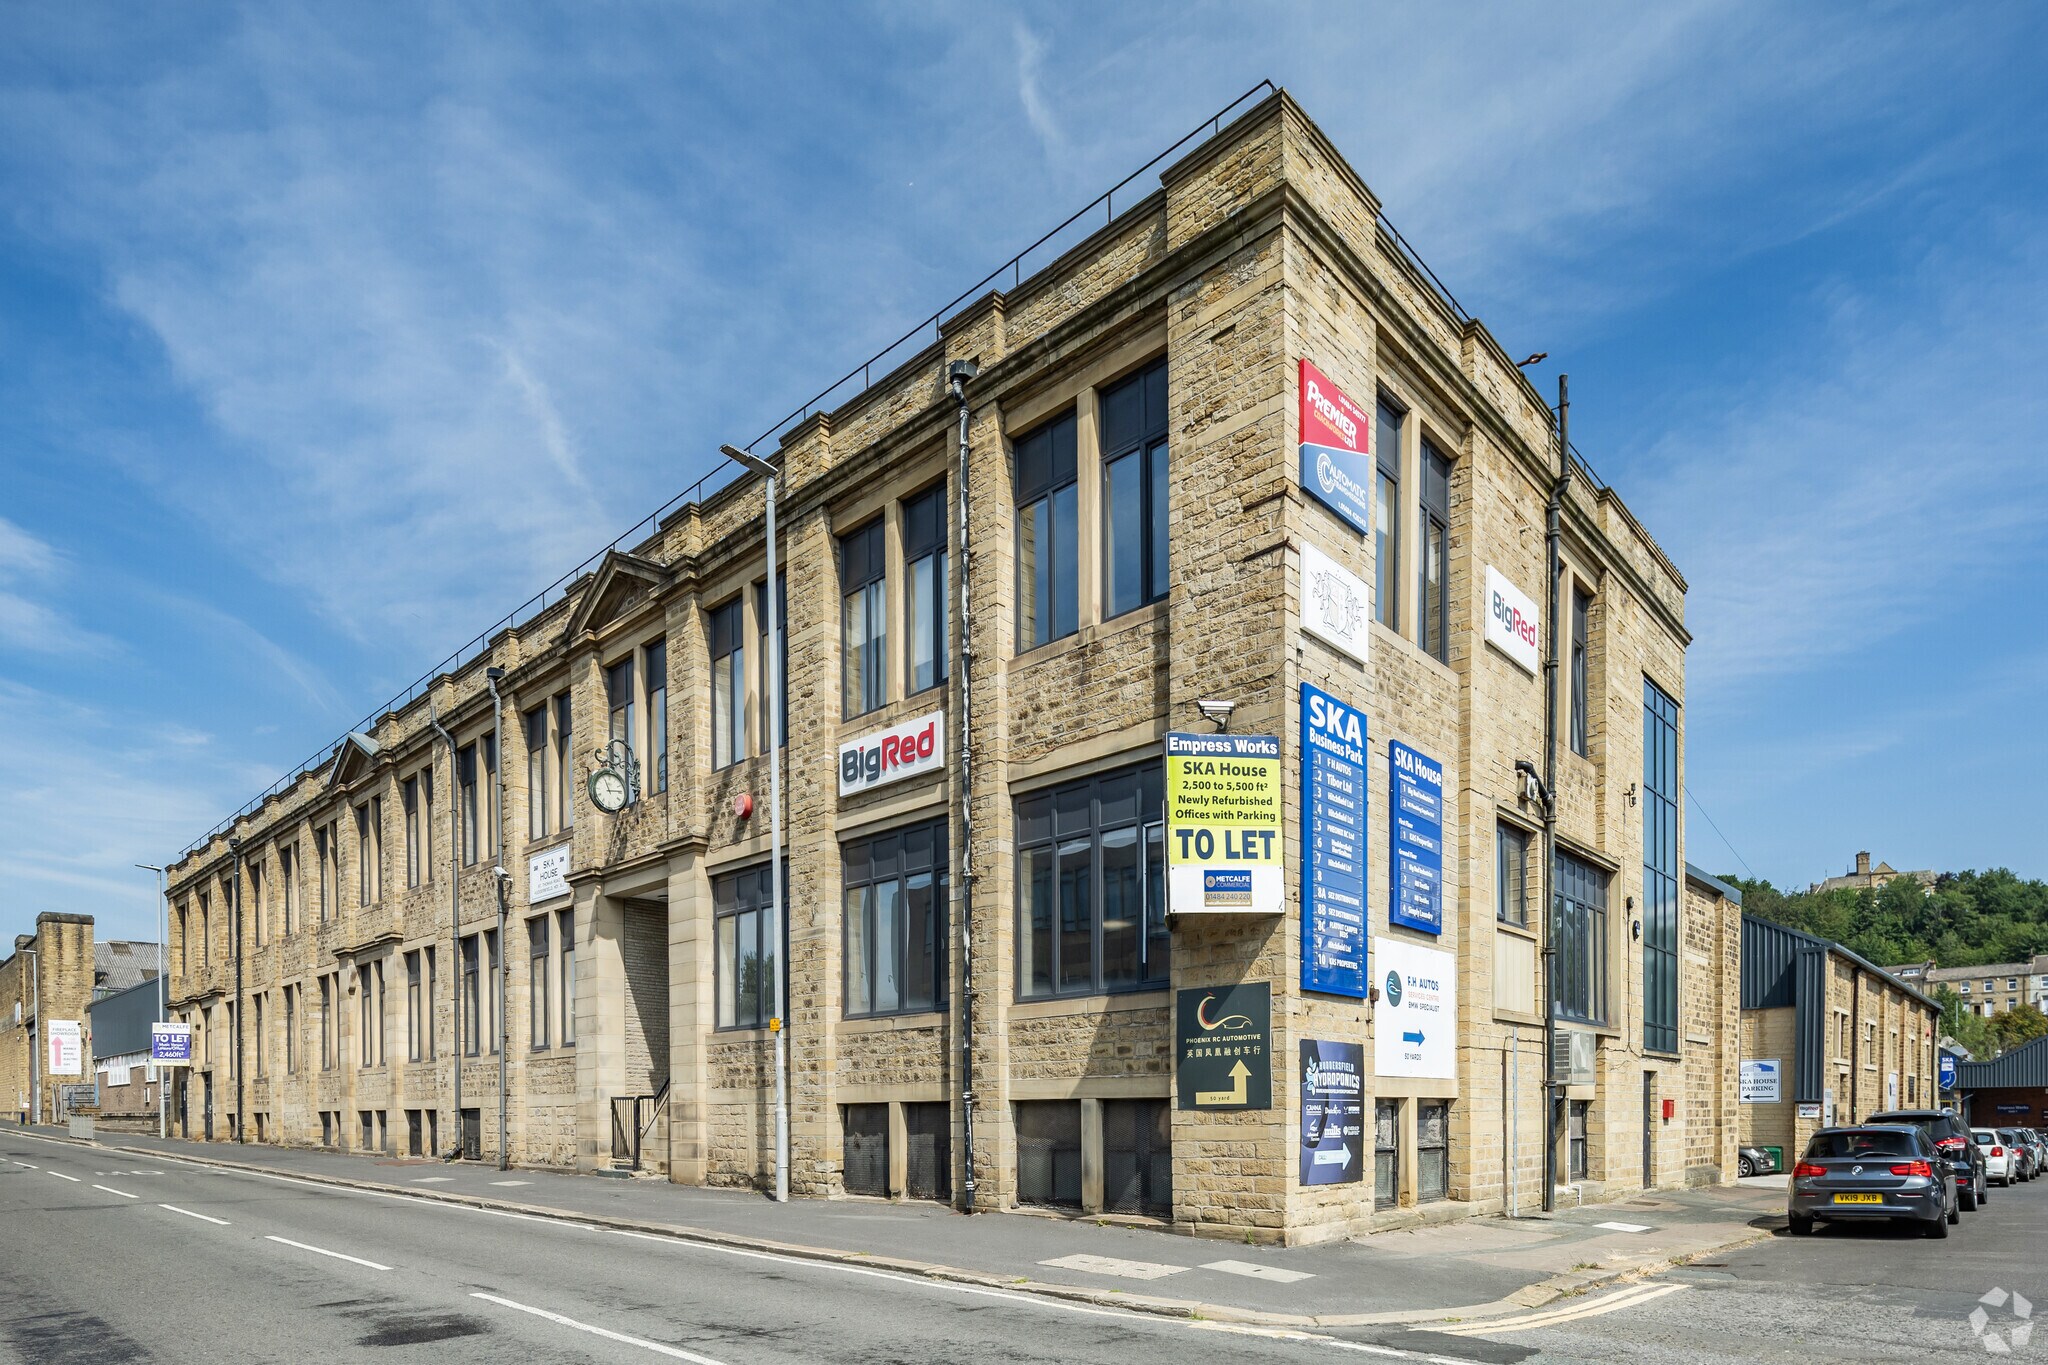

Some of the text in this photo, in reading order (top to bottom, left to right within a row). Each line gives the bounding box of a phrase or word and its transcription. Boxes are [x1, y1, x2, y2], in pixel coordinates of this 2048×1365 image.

[1307, 380, 1356, 449] PREMIER
[1314, 410, 1353, 448] COACHWORKS LTD
[1330, 464, 1366, 502] AUTOMATIC
[1333, 478, 1366, 510] TRANSMISSIONS
[1493, 590, 1536, 647] BigRed
[1310, 694, 1363, 748] SKA
[842, 722, 934, 782] BigRed
[1169, 737, 1278, 755] Empress Works
[1310, 726, 1363, 766] Business Park
[1183, 761, 1267, 777] SKA House
[1318, 754, 1321, 764] 1
[1336, 762, 1352, 776] AUTOS
[1395, 747, 1442, 787] SKA House
[1182, 780, 1268, 792] 2,500 to 5,500 ft²
[1318, 770, 1352, 794] 2 Tibor Ltd
[1317, 787, 1322, 798] 3
[1178, 795, 1272, 806] Newly Refurbished
[1402, 799, 1406, 808] 2
[1175, 809, 1276, 822] Offices with Parking
[1317, 804, 1322, 815] 4
[1317, 820, 1322, 831] 5
[1176, 828, 1276, 860] TO LET
[1317, 837, 1322, 848] 6
[543, 859, 554, 869] SKA
[1317, 853, 1321, 864] 7
[540, 868, 558, 881] HOUSE
[1317, 870, 1322, 881] 8
[1318, 887, 1326, 899] 8A
[1336, 893, 1359, 906] DISTRIBUTION
[1318, 904, 1326, 915] 8B
[1336, 910, 1360, 923] DISTRIBUTION
[1420, 910, 1433, 922] Laundry
[1318, 920, 1326, 932] 8C
[1318, 937, 1322, 948] 9
[1318, 954, 1326, 965] 10
[1337, 959, 1358, 970] PROPERTIES
[1419, 978, 1439, 991] AUTOS
[1420, 1003, 1439, 1012] SPECIALIST
[154, 1034, 189, 1043] TO LET
[1319, 1061, 1354, 1073] HUDDERSFIELD
[1314, 1072, 1360, 1090] HYDROPONICS
